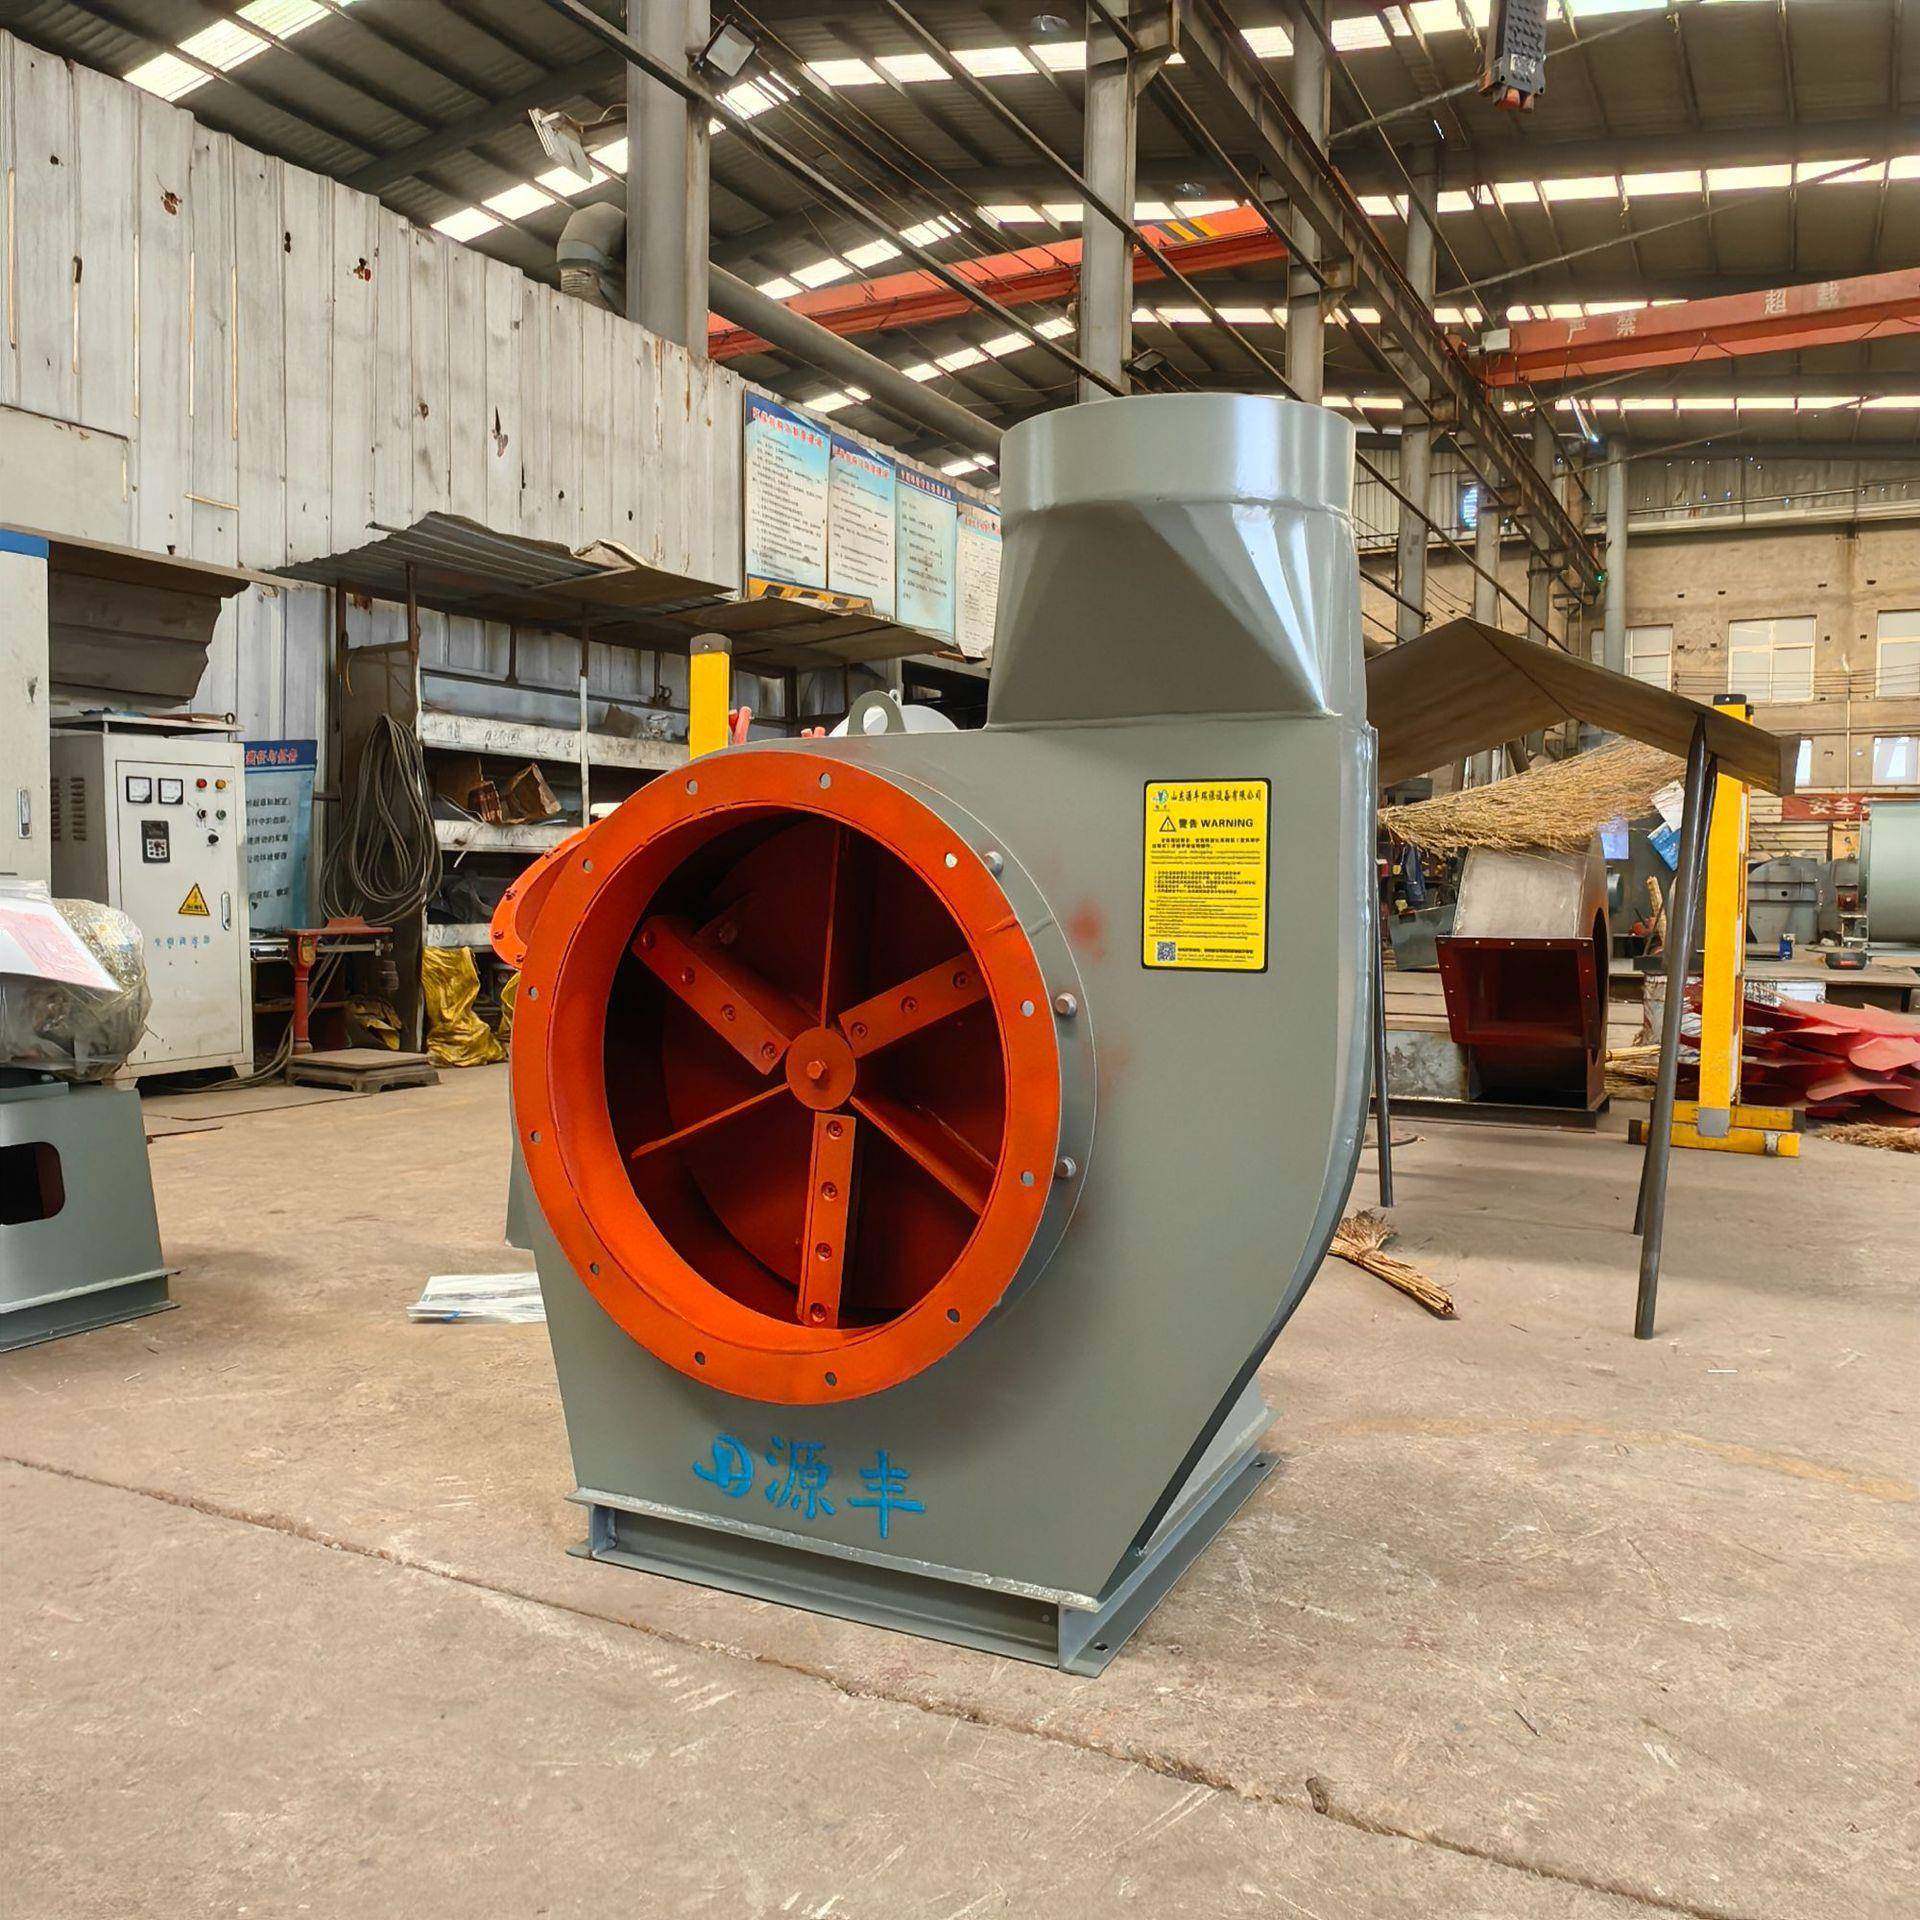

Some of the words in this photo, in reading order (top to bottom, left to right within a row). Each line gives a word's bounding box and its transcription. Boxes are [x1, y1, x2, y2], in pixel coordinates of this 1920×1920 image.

[1179, 819, 1197, 828] 警告
[1201, 818, 1253, 827] WARNING
[765, 1435, 926, 1539] 源丰
